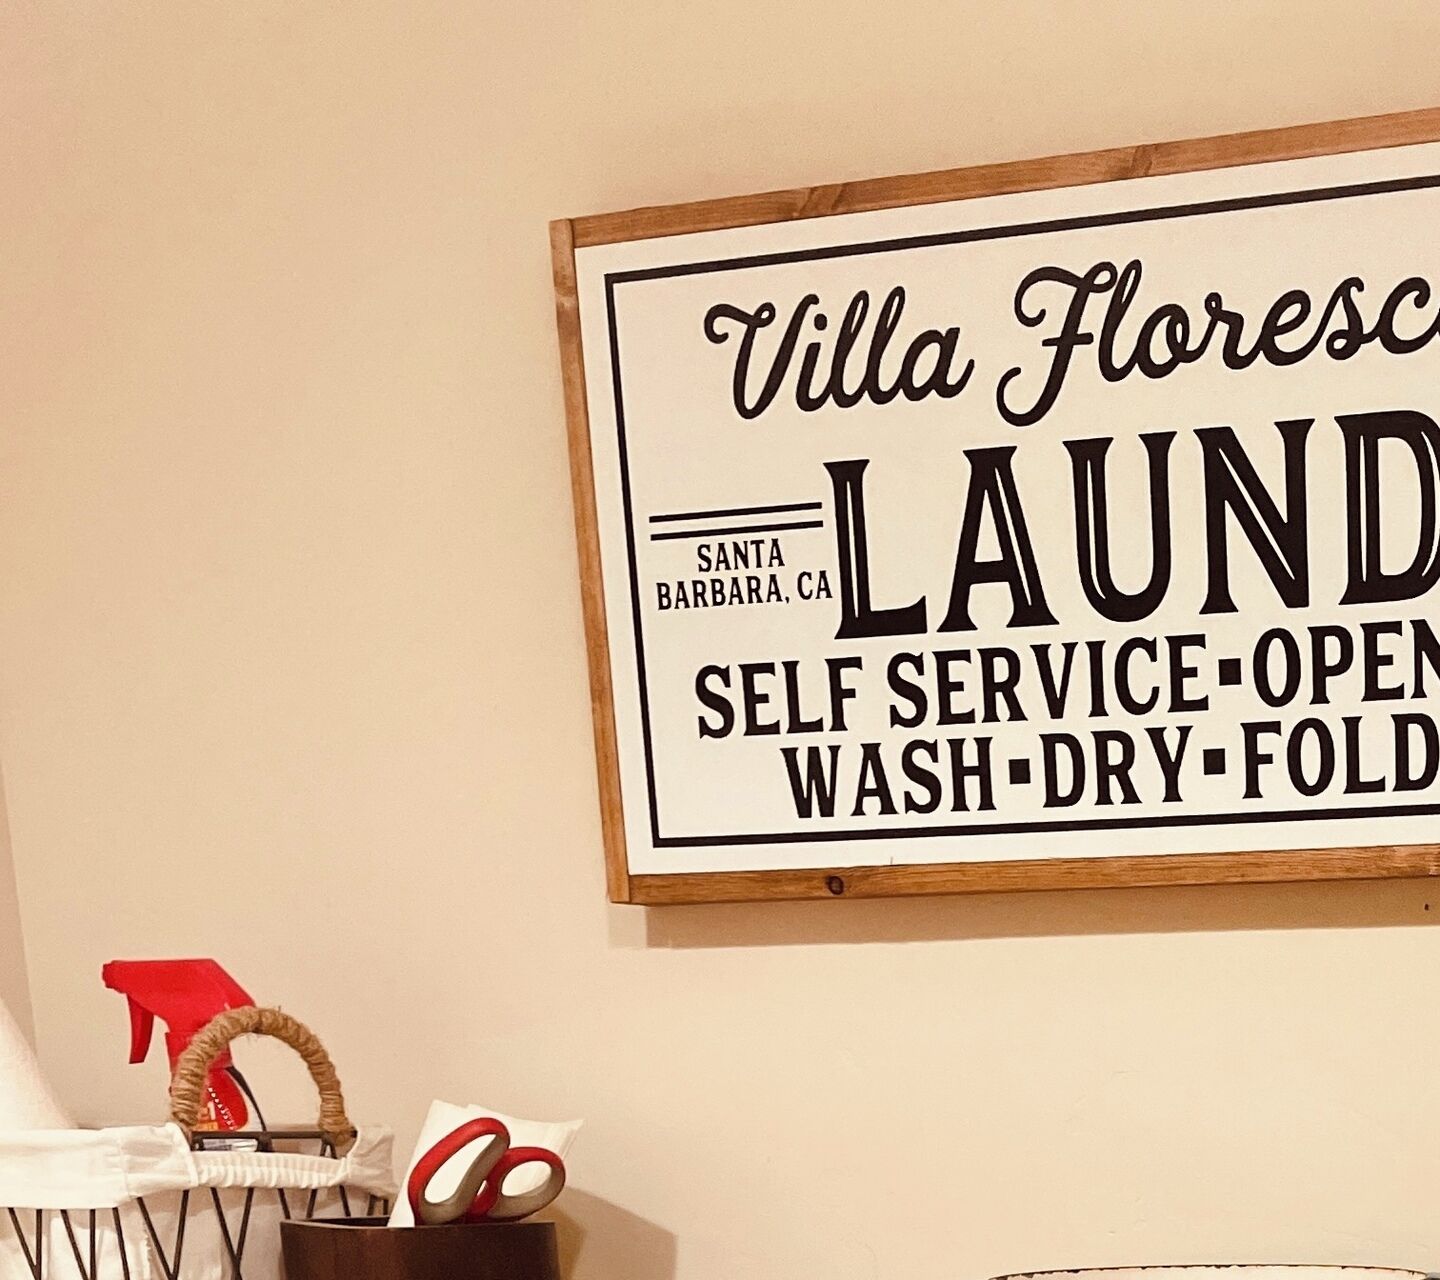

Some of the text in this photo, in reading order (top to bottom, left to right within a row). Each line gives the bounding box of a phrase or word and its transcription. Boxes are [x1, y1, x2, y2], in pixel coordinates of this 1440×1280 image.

[704, 285, 975, 420] Villa
[656, 571, 834, 611] BARBARA, CA
[697, 538, 785, 573] SANTA
[694, 655, 864, 740] SELF
[886, 634, 1209, 729] SERVICE
[781, 737, 995, 820] WASH
[1039, 725, 1194, 809] DRY
[1241, 713, 1440, 801] FOLD
